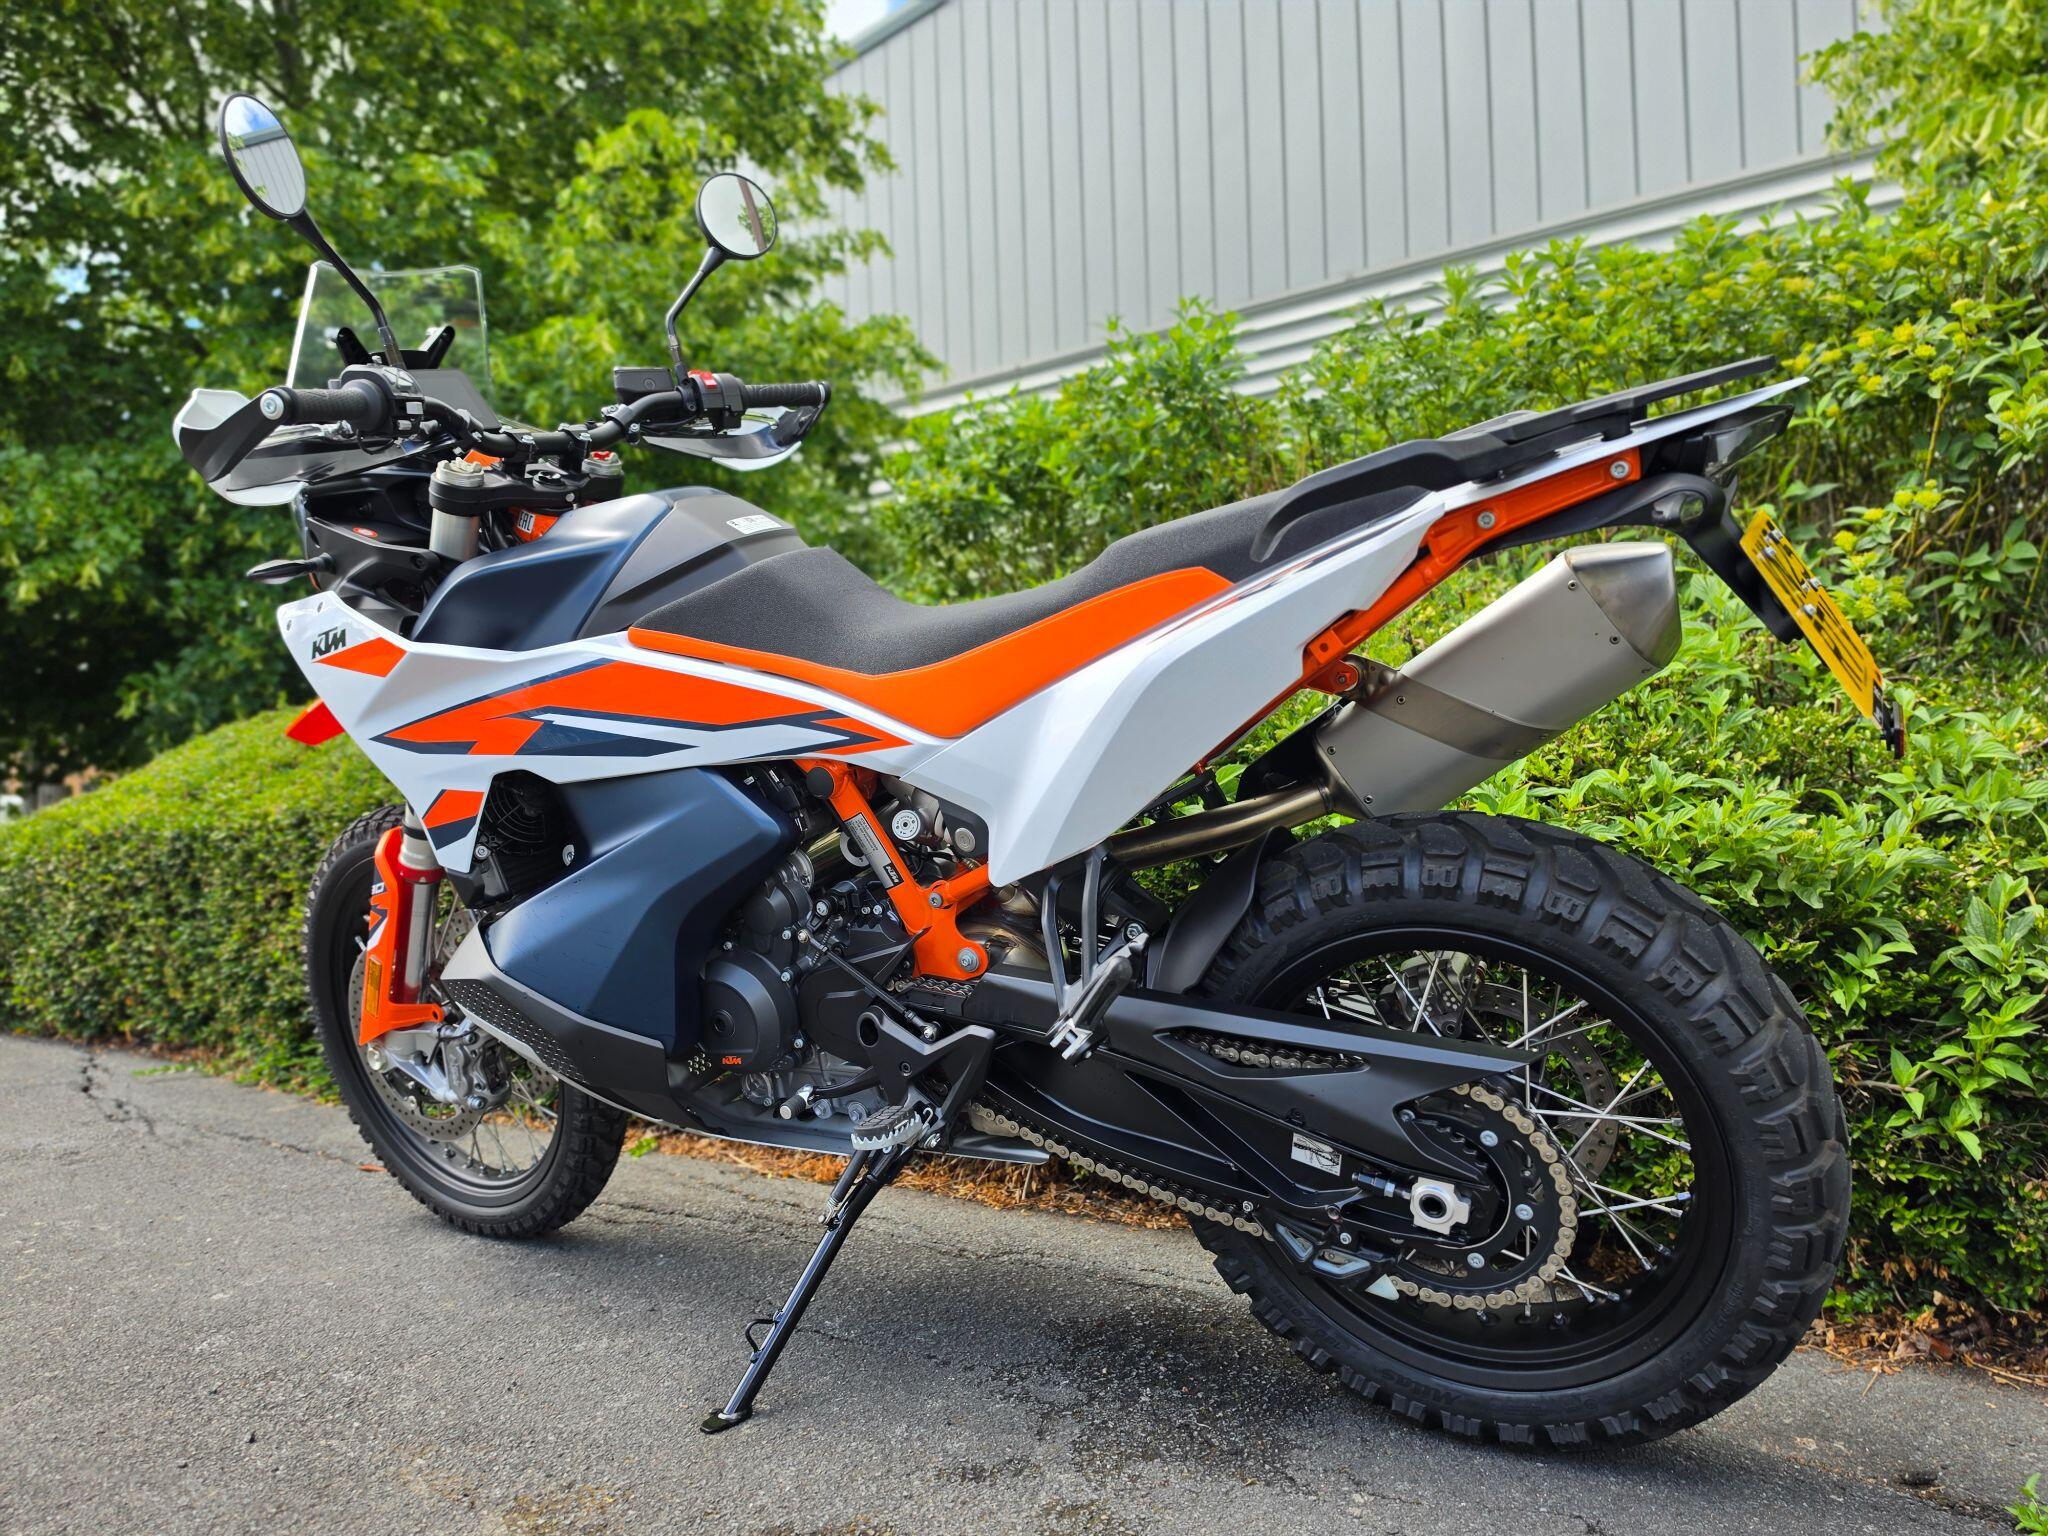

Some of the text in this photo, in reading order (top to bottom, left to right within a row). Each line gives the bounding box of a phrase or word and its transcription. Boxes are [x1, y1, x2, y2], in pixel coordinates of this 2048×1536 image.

[312, 626, 346, 660] KTM
[886, 866, 899, 882] KTM
[722, 1055, 742, 1065] KTM
